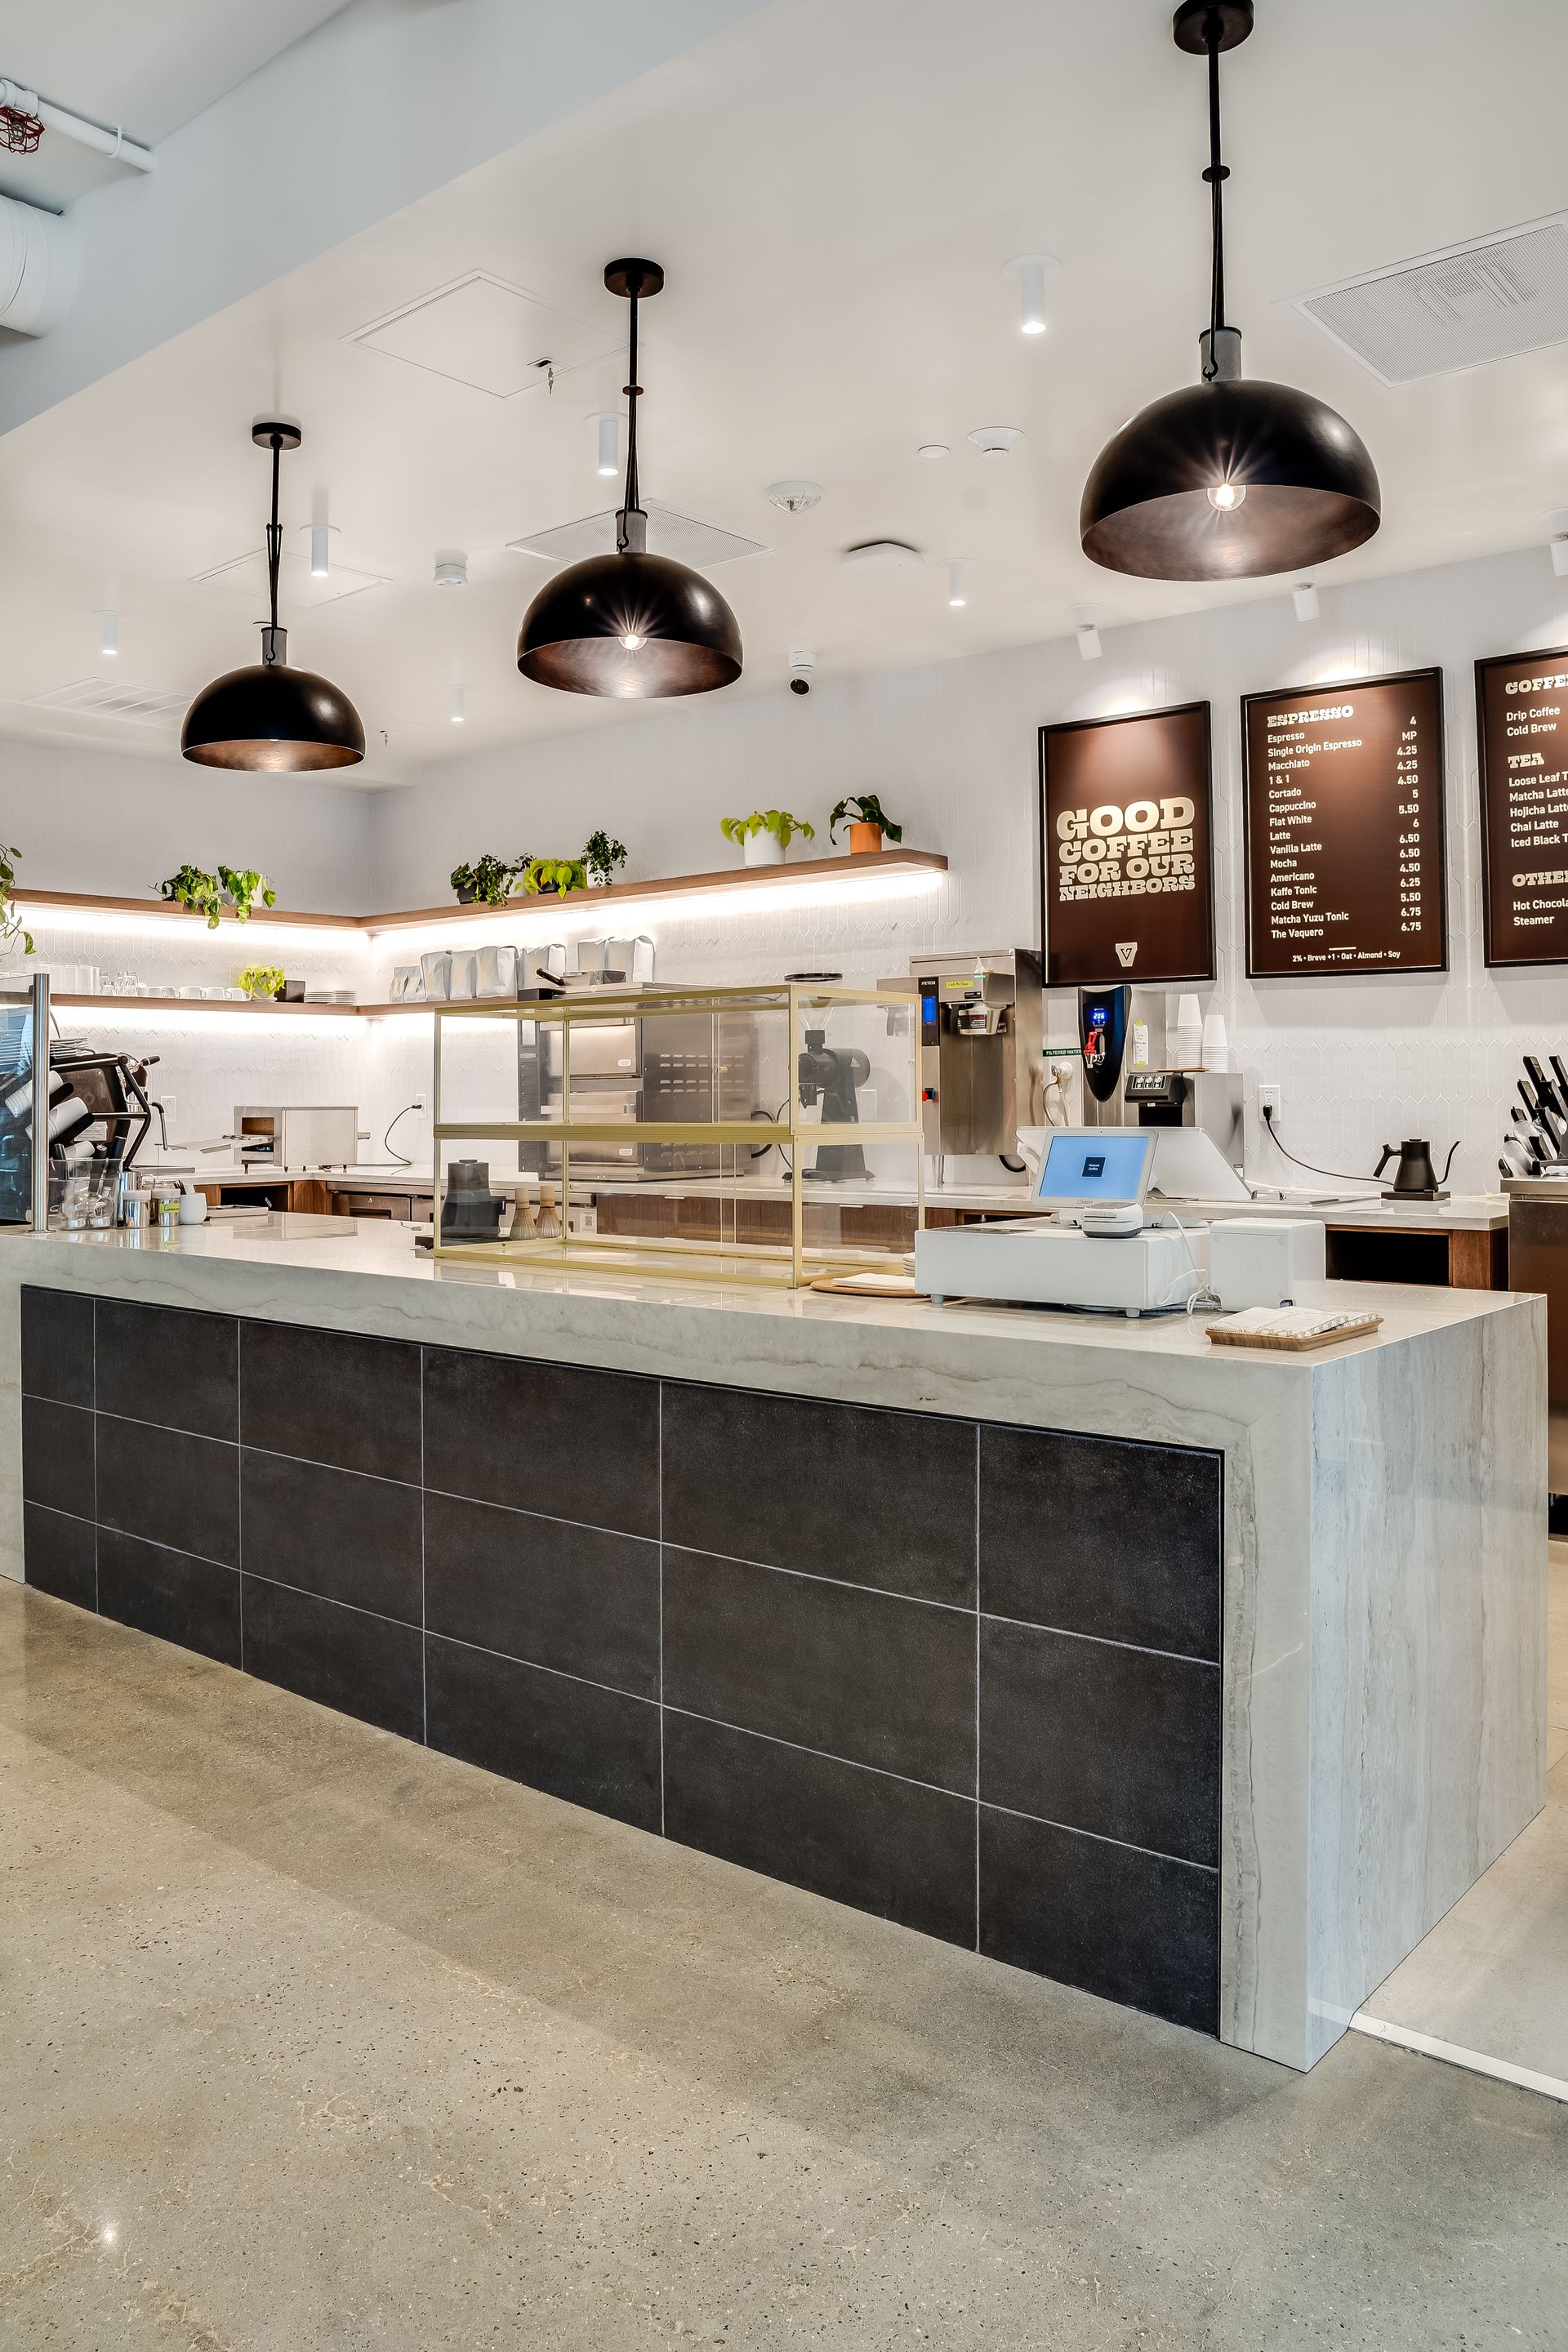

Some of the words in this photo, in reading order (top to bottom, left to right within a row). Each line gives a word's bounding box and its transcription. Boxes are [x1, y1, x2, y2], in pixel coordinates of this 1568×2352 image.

[1506, 674, 1568, 694] COFFE
[1267, 706, 1353, 727] ESPRESSO
[1507, 711, 1527, 721] Drip
[1529, 707, 1560, 718] Coffee
[1410, 716, 1416, 725] 4
[1507, 725, 1528, 736] Cold
[1531, 723, 1557, 733] Brew
[1268, 733, 1304, 744] Espresso
[1402, 731, 1417, 741] MP
[1268, 747, 1293, 757] Single
[1296, 743, 1321, 754] Origin
[1323, 739, 1362, 751] Espresso
[1397, 745, 1417, 756] 4.25
[1268, 760, 1310, 771] Macchiato
[1397, 760, 1417, 770] 4.25
[1508, 753, 1544, 768] TEA
[1269, 776, 1273, 785] 1
[1276, 776, 1283, 784] &
[1285, 775, 1289, 783] 1
[1398, 775, 1418, 785] 4.50
[1509, 777, 1536, 787] Loose
[1539, 772, 1560, 783] Leaf
[1269, 788, 1301, 799] Cortado
[1413, 789, 1418, 798] 5
[1510, 791, 1544, 802] Matcha
[1270, 801, 1316, 813] Cappuccino
[1399, 804, 1419, 814] 5.50
[1510, 806, 1545, 818] Hojicha
[1548, 803, 1568, 813] Latt
[1057, 797, 1195, 841] GOOD
[1270, 817, 1286, 826] Flat
[1287, 815, 1312, 825] White
[1413, 819, 1419, 827] 6
[1511, 822, 1531, 832] Chai
[1534, 820, 1559, 830] Latte
[1270, 832, 1290, 841] Latte
[1399, 834, 1419, 843] 6.50
[1511, 837, 1530, 847] Iced
[1533, 834, 1560, 845] Black
[1059, 828, 1193, 863] COFFEE
[1270, 844, 1298, 854] Vanilla
[1301, 843, 1322, 852] Latte
[1400, 848, 1420, 858] 6.50
[1271, 859, 1297, 868] Mocha
[1400, 863, 1420, 872] 4.50
[1060, 861, 1120, 885] FOR
[1127, 854, 1194, 878] OUR
[1271, 872, 1314, 882] Americano
[1401, 878, 1420, 887] 6.25
[1060, 875, 1195, 901] NEIGHBORS
[1271, 887, 1293, 896] Kaffe
[1294, 885, 1317, 895] Tonic
[1401, 892, 1420, 902] 5.50
[1271, 901, 1289, 910] Cold
[1292, 901, 1313, 909] Brew
[1513, 901, 1530, 910] Hot
[1401, 907, 1421, 916] 6.75
[1272, 915, 1301, 924] Matcha
[1303, 913, 1324, 922] Yuzu
[1326, 912, 1349, 921] Tonic
[1514, 916, 1554, 926] Steamer
[1401, 922, 1421, 931] 6.75
[1271, 930, 1287, 938] The
[1289, 929, 1323, 938] Vaquero
